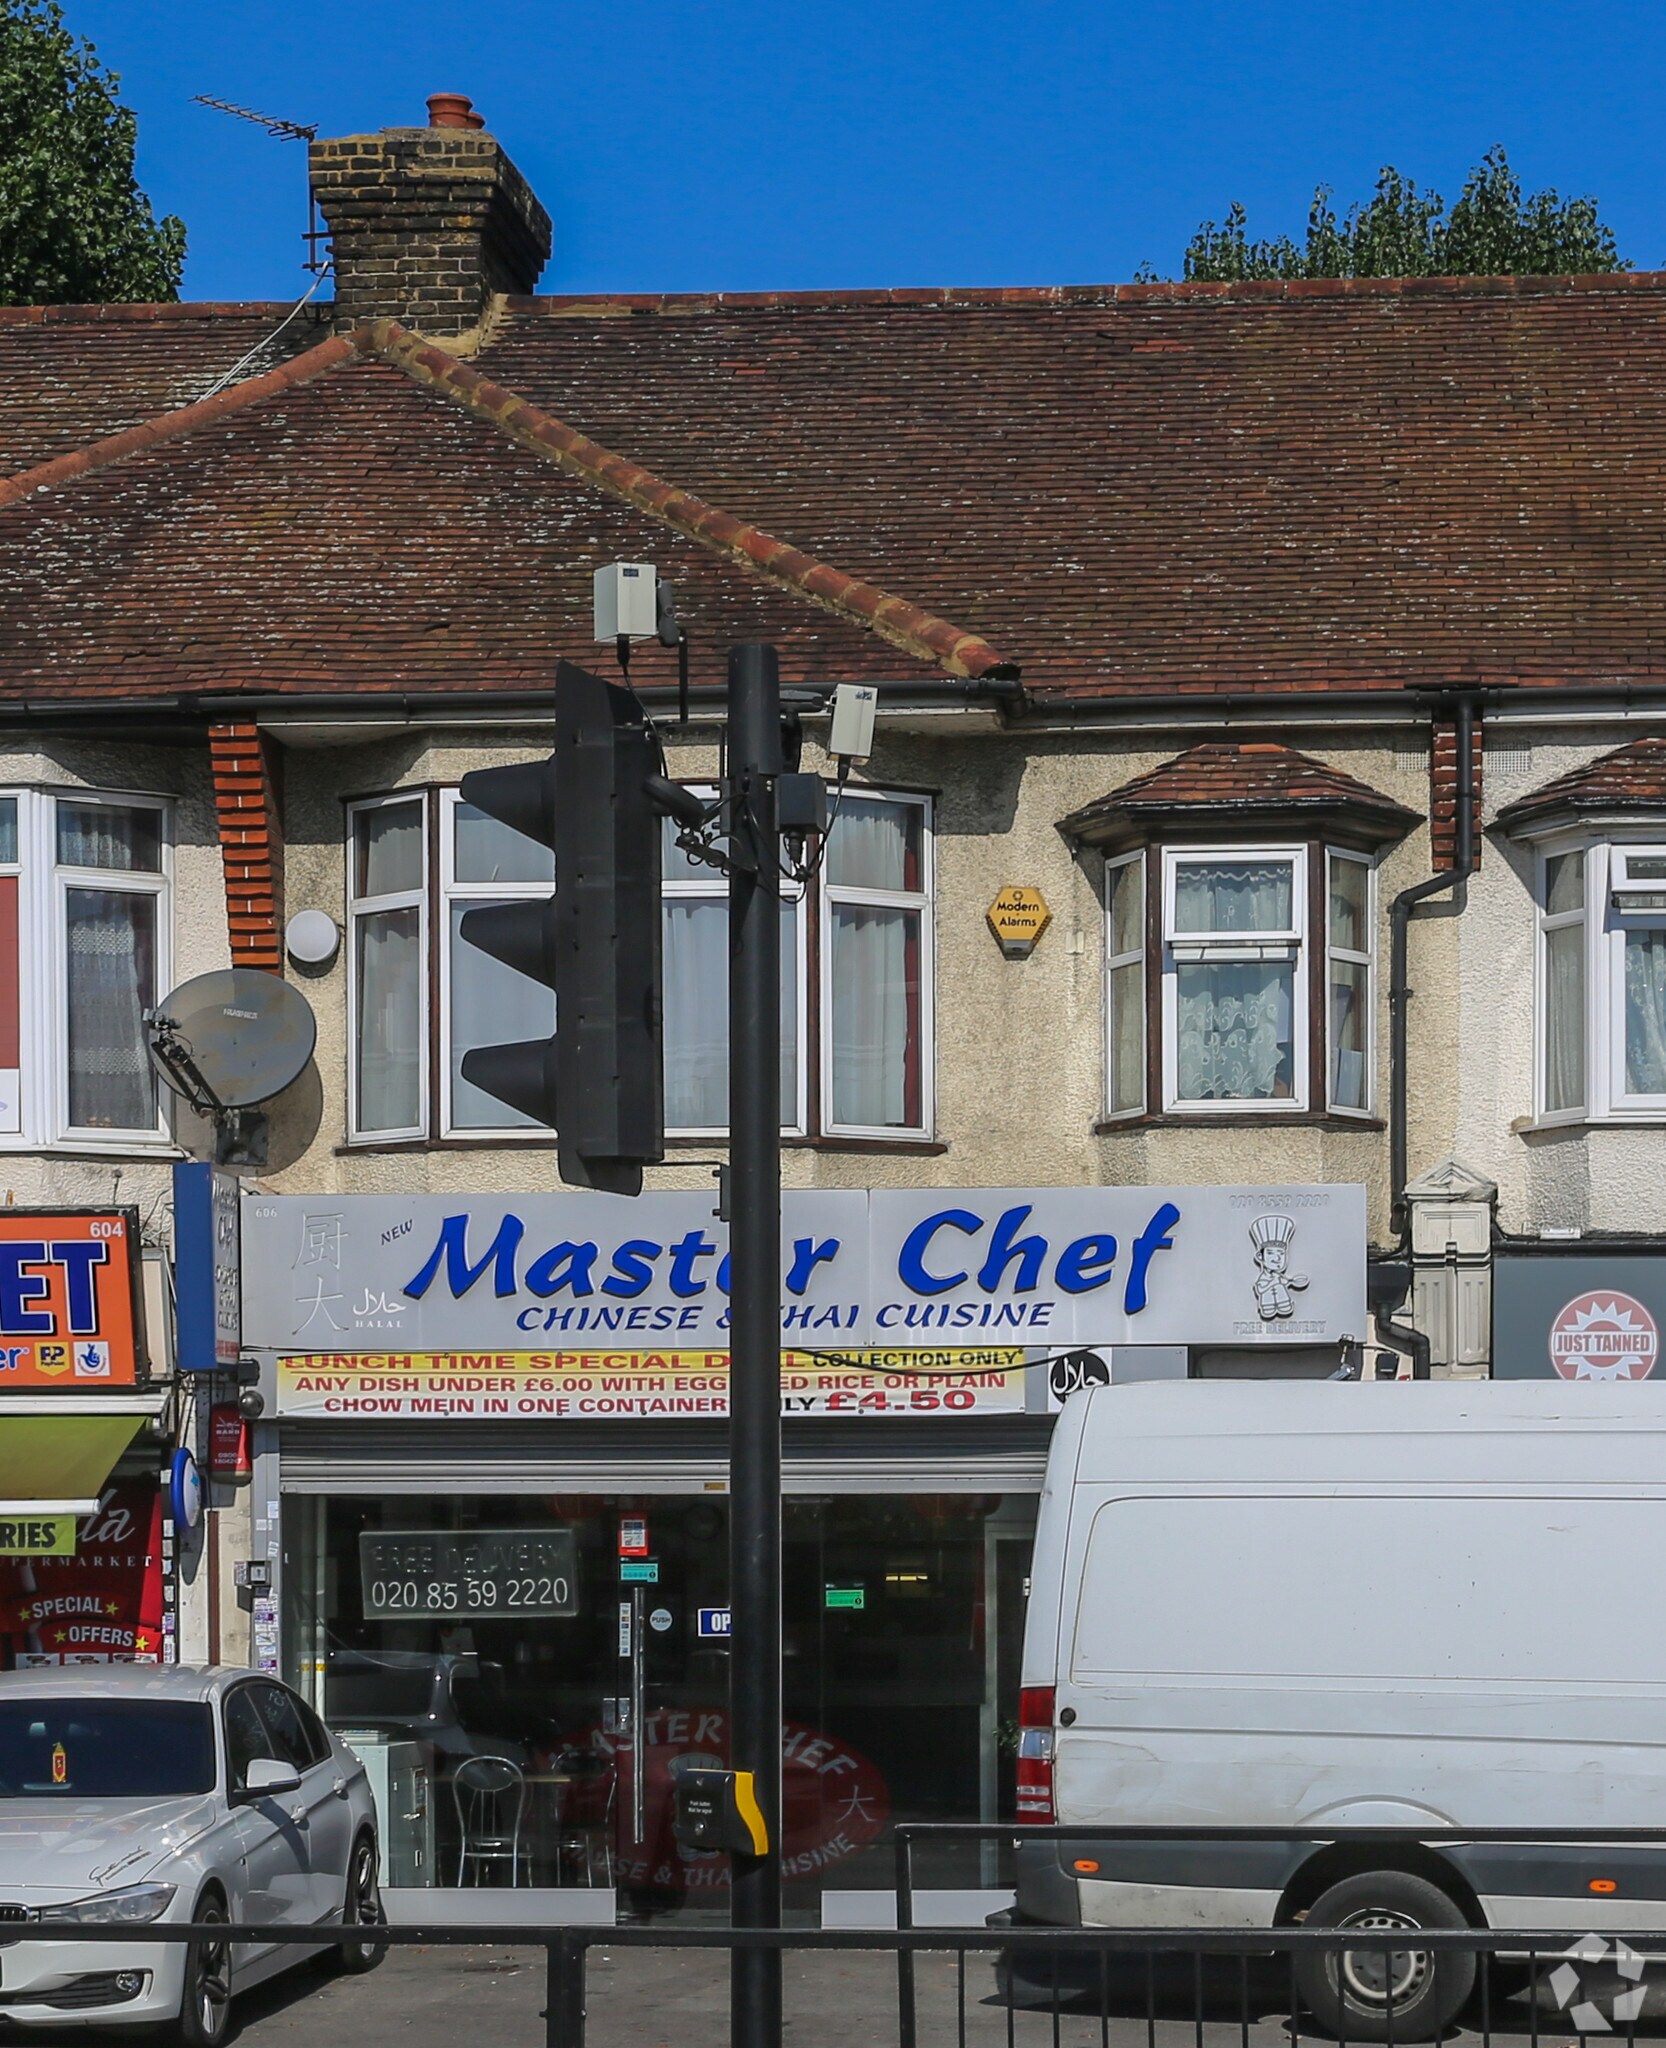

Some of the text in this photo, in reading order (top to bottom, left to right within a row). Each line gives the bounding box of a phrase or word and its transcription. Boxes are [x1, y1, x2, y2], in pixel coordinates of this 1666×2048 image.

[997, 902, 1040, 912] Modern
[999, 916, 1037, 927] Alarms
[255, 1207, 278, 1218] 606
[90, 1222, 123, 1237] 604
[380, 1218, 413, 1246] NEW
[402, 1202, 1181, 1315] Mastr Chef
[353, 1288, 406, 1315] حلال
[355, 1320, 403, 1329] HALAL
[516, 1305, 704, 1331] CHINESE
[780, 1304, 859, 1329] HAI
[875, 1301, 1055, 1328] CUISINE
[1557, 1334, 1651, 1352] JUST TANNED
[285, 1354, 412, 1370] LUNCH
[425, 1354, 515, 1370] TIME
[529, 1354, 691, 1370] SPECIAL
[812, 1351, 950, 1368] COLLECTION
[959, 1350, 1017, 1366] ONLY
[295, 1377, 351, 1392] ANY
[359, 1377, 419, 1392] DISH
[428, 1377, 516, 1392] UNDER
[524, 1377, 593, 1392] £6.00
[601, 1376, 665, 1392] WITH
[674, 1376, 727, 1392] EGG
[818, 1375, 875, 1390] RICE
[883, 1374, 919, 1389] OR
[928, 1373, 1006, 1389] PLAIN
[324, 1397, 403, 1413] CHOW
[410, 1398, 475, 1413] MEIN
[483, 1398, 509, 1413] IN
[517, 1398, 571, 1413] ONE
[578, 1397, 728, 1414] CONTAINER
[824, 1389, 976, 1412] £4.50
[371, 1577, 568, 1610] 020 85 59 2220
[32, 1597, 103, 1618] SPECIAL
[69, 1626, 134, 1647] OFFERS
[836, 1784, 877, 1822] 大
[652, 1864, 672, 1885] &
[681, 1866, 731, 1887] THA
